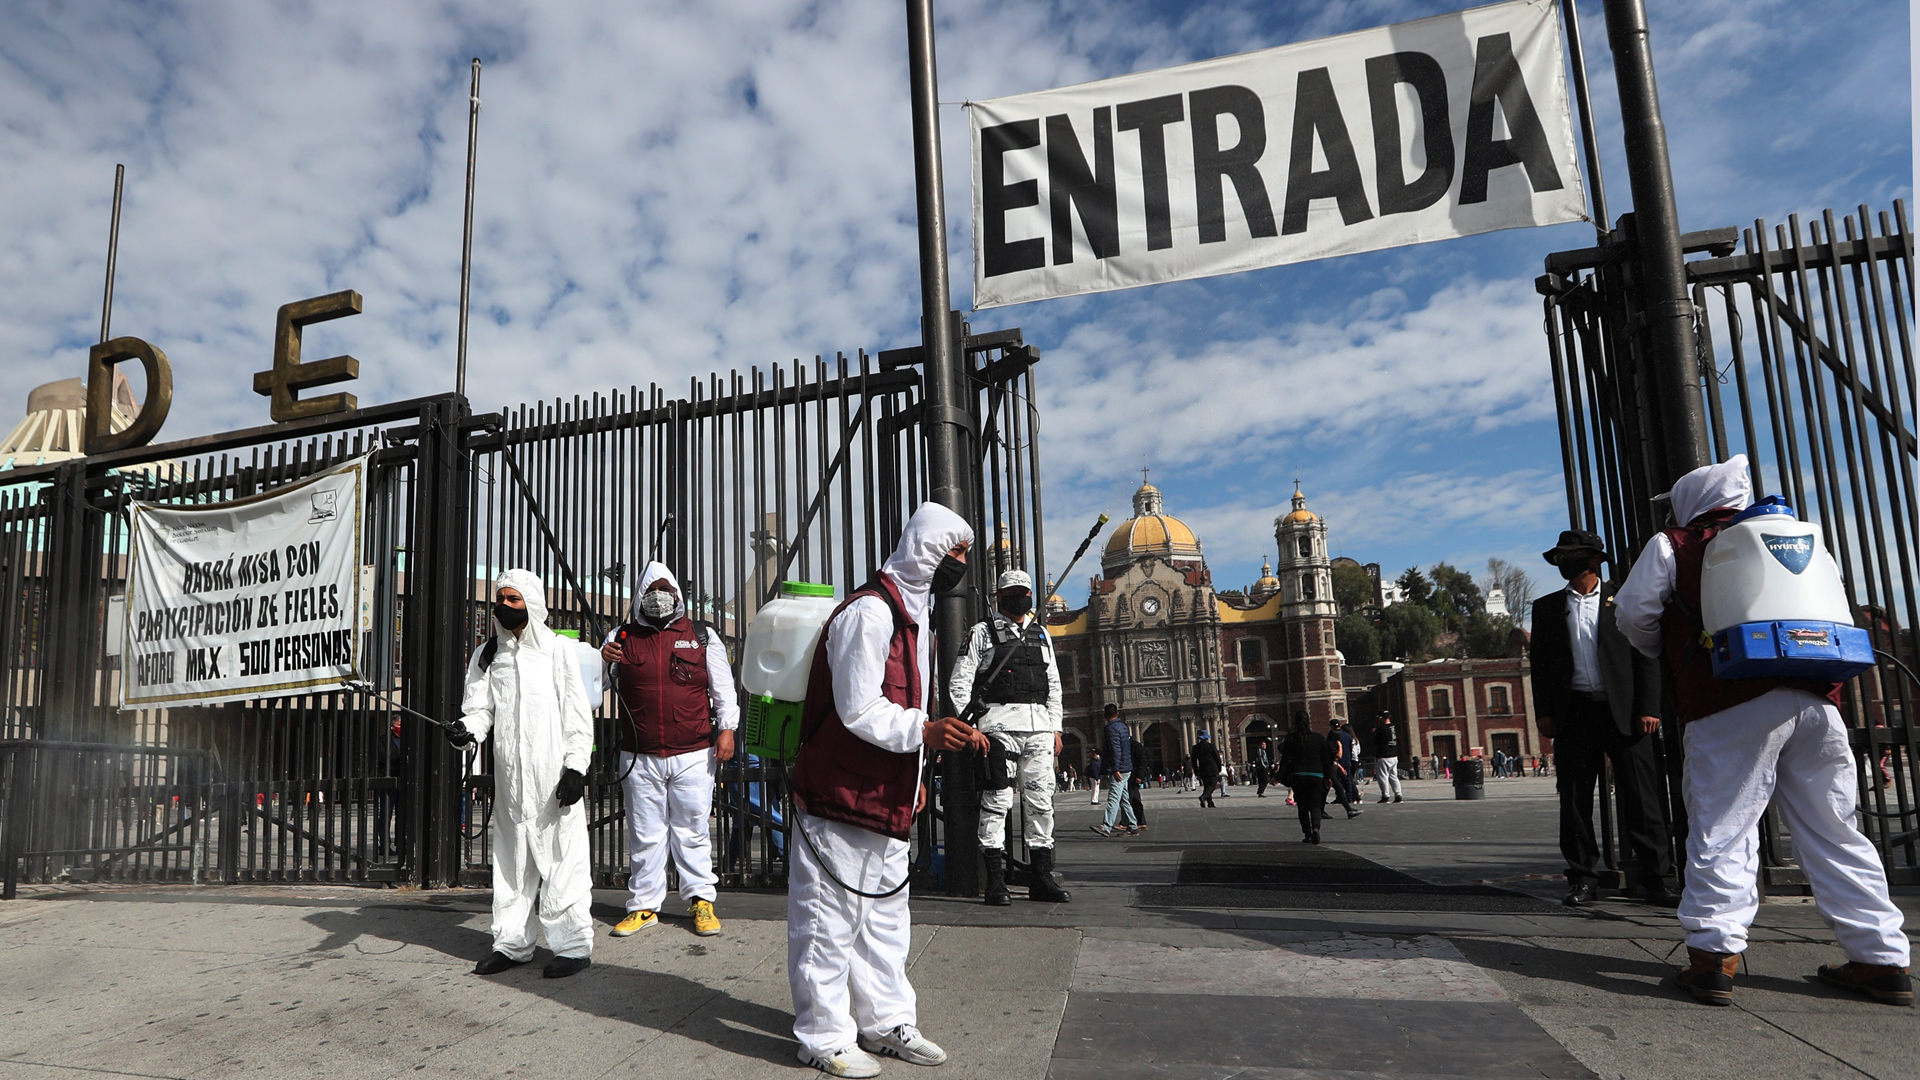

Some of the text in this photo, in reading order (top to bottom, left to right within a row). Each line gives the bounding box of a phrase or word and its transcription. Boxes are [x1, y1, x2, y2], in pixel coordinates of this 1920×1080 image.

[980, 31, 1564, 279] ENTRADA
[183, 541, 320, 594] HABRÁ MISA CON
[256, 594, 278, 628] DE
[285, 583, 343, 625] FIELES,
[137, 629, 351, 687] AFORO MAX. 500 PERSONAS
